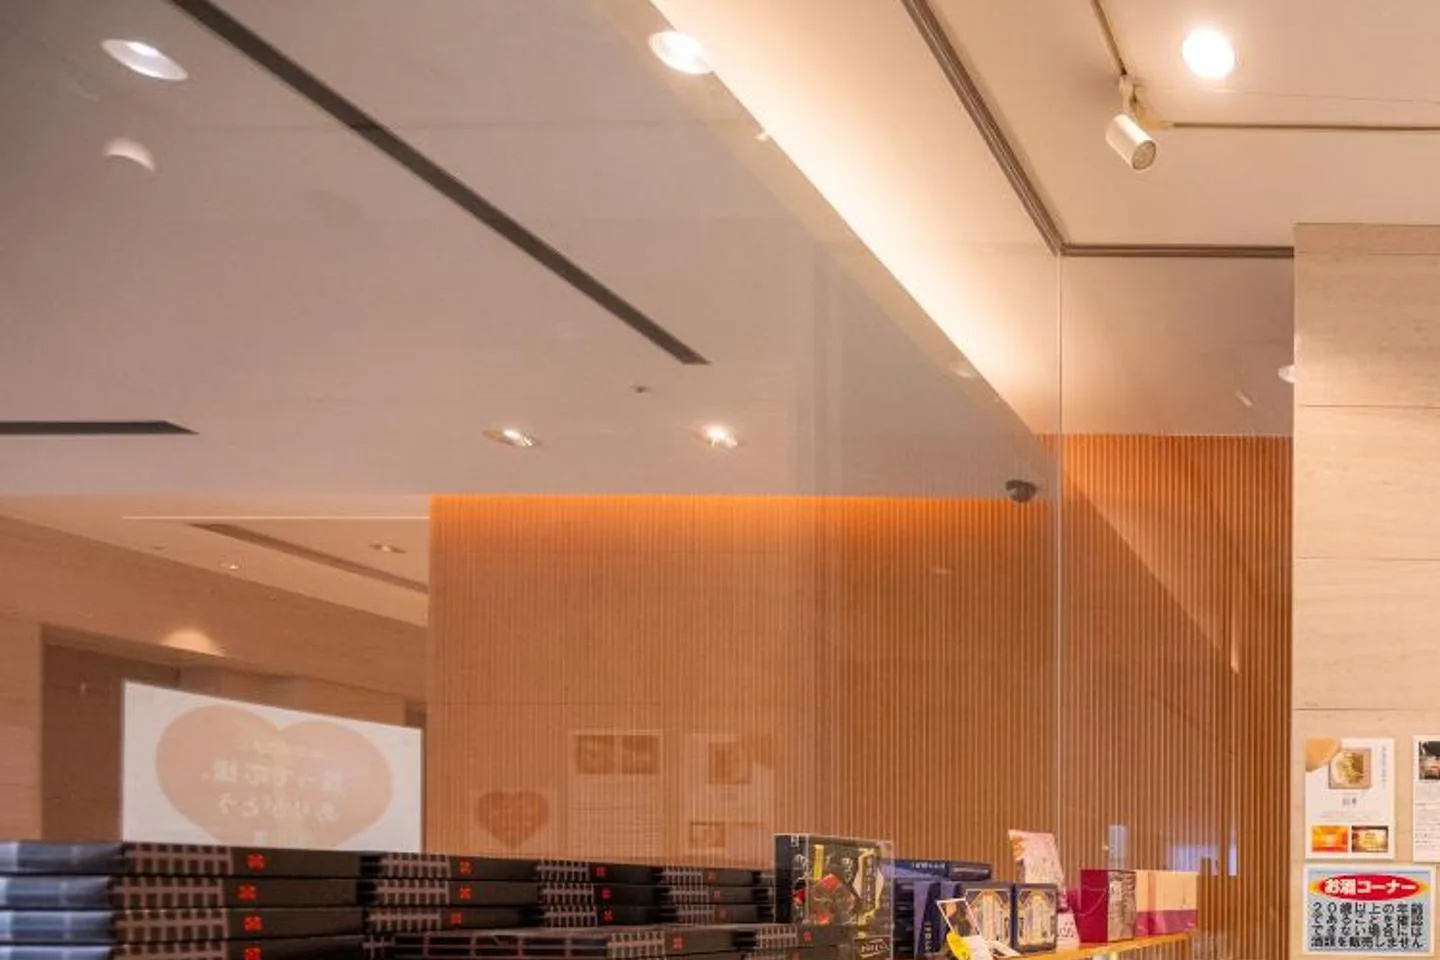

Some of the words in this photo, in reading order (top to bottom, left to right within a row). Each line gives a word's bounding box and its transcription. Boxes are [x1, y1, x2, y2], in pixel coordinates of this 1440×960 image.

[1325, 877, 1417, 896] お酒コーナー
